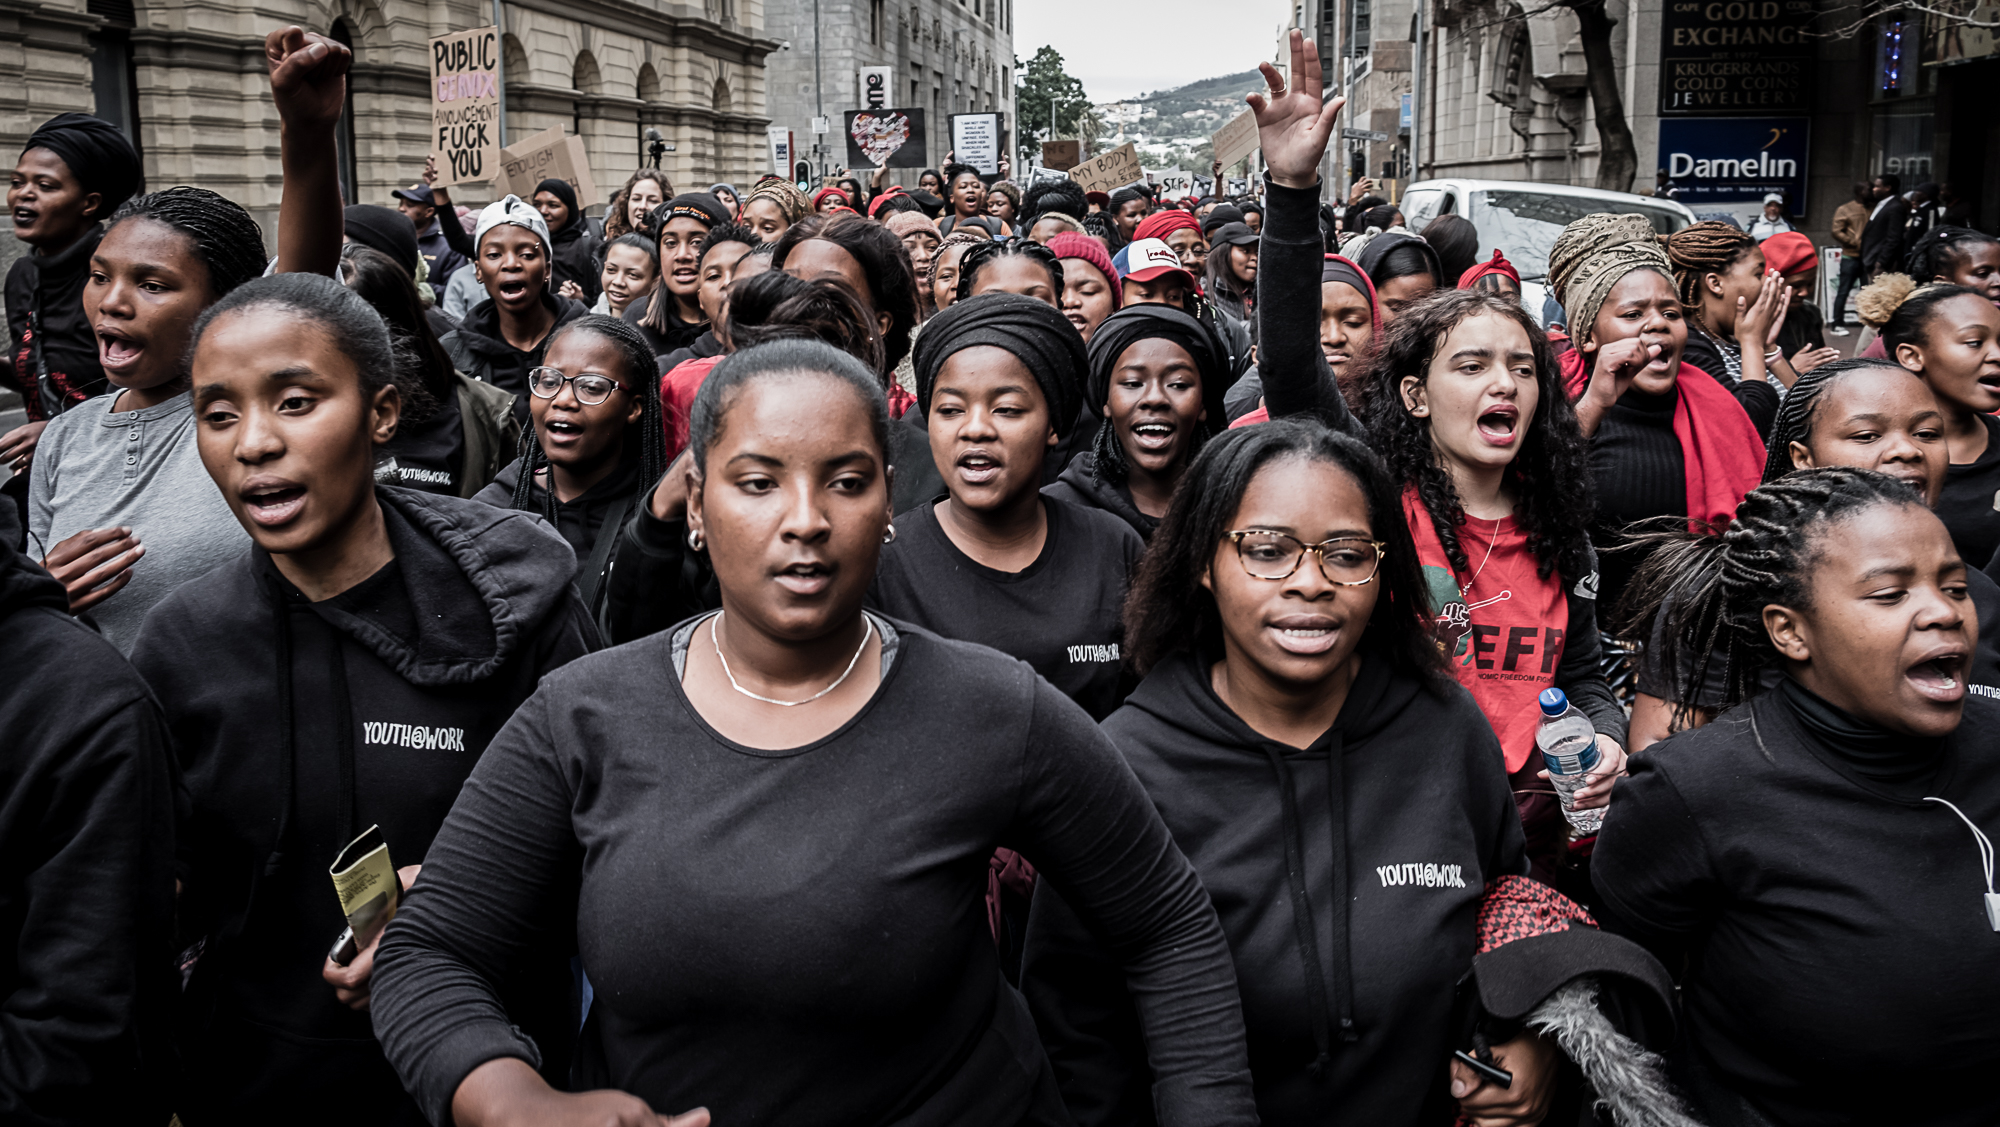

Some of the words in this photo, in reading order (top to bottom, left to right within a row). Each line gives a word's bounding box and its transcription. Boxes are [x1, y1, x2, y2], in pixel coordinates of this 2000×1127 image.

[1674, 3, 1699, 12] CAPE
[1705, 1, 1780, 21] GOLD
[1673, 26, 1810, 46] EXCHANGE
[433, 32, 496, 77] PUBLIC
[1675, 61, 1801, 76] KRUGERRANDS
[1674, 77, 1727, 91] GOLD
[1741, 76, 1799, 90] COINS
[1672, 91, 1799, 107] JEWELLERY
[433, 102, 499, 126] ANNOUNCEMENT
[439, 123, 490, 151] FUCK
[447, 149, 483, 182] YOU
[1072, 165, 1093, 182] MY
[1096, 148, 1129, 173] BODY
[1669, 151, 1797, 178] Damelin
[1500, 674, 1535, 682] FREEDOM
[363, 721, 465, 752] YOUTH@WORK
[1376, 862, 1466, 889] YOUTH@WORK
